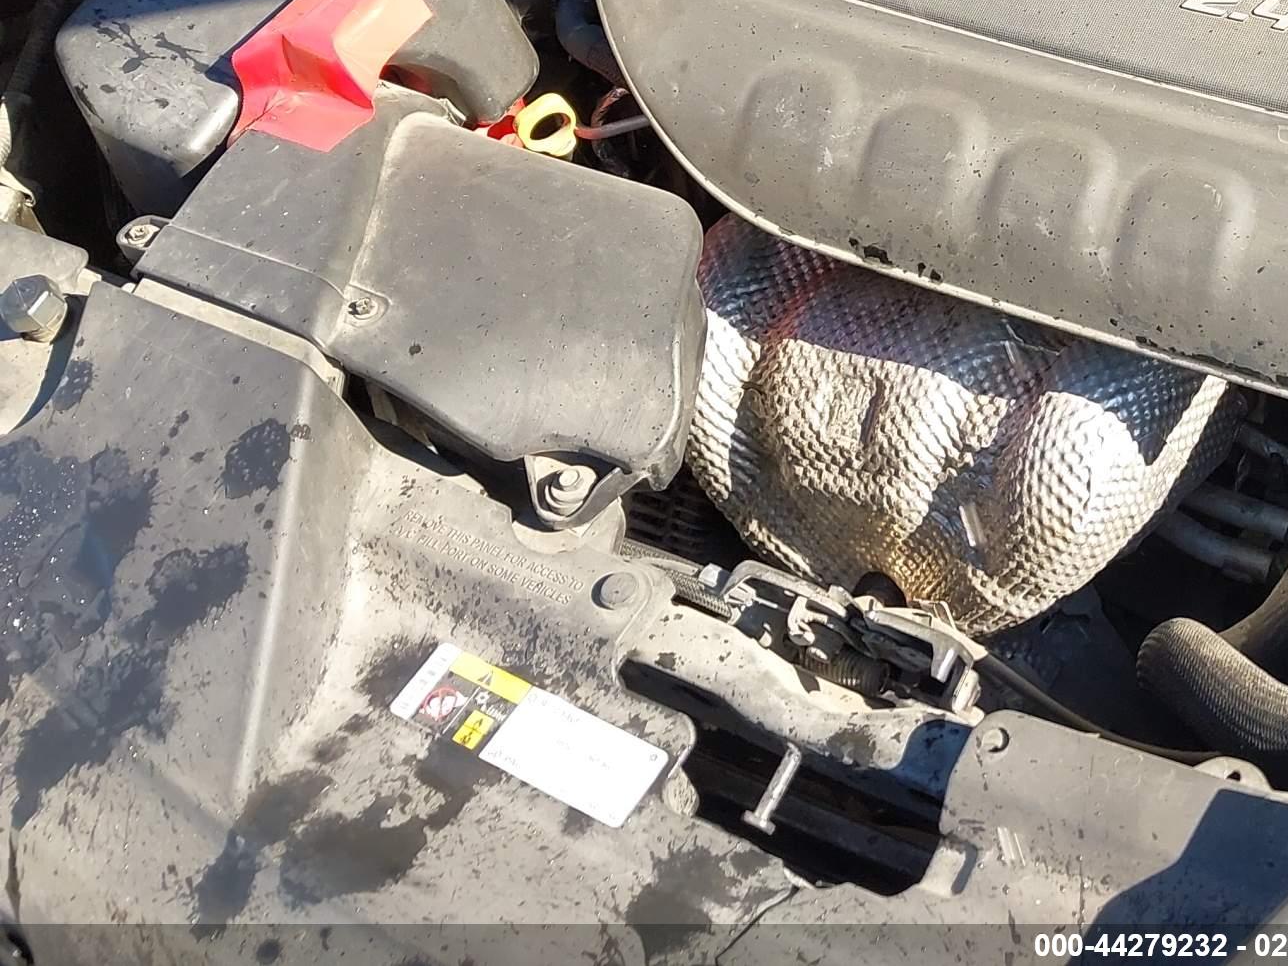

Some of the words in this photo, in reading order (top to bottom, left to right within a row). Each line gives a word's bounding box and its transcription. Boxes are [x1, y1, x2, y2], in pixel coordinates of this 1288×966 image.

[403, 509, 447, 534] REMOVE
[447, 528, 472, 544] THIS
[471, 537, 505, 557] PANEL
[503, 552, 528, 568] FOR
[526, 561, 568, 585] ACCESS
[568, 577, 584, 592] TO
[416, 534, 440, 551] FILL
[439, 541, 468, 563] PORT
[470, 557, 489, 571] ON
[487, 563, 520, 584] SOME
[519, 577, 572, 605] VEHICLES
